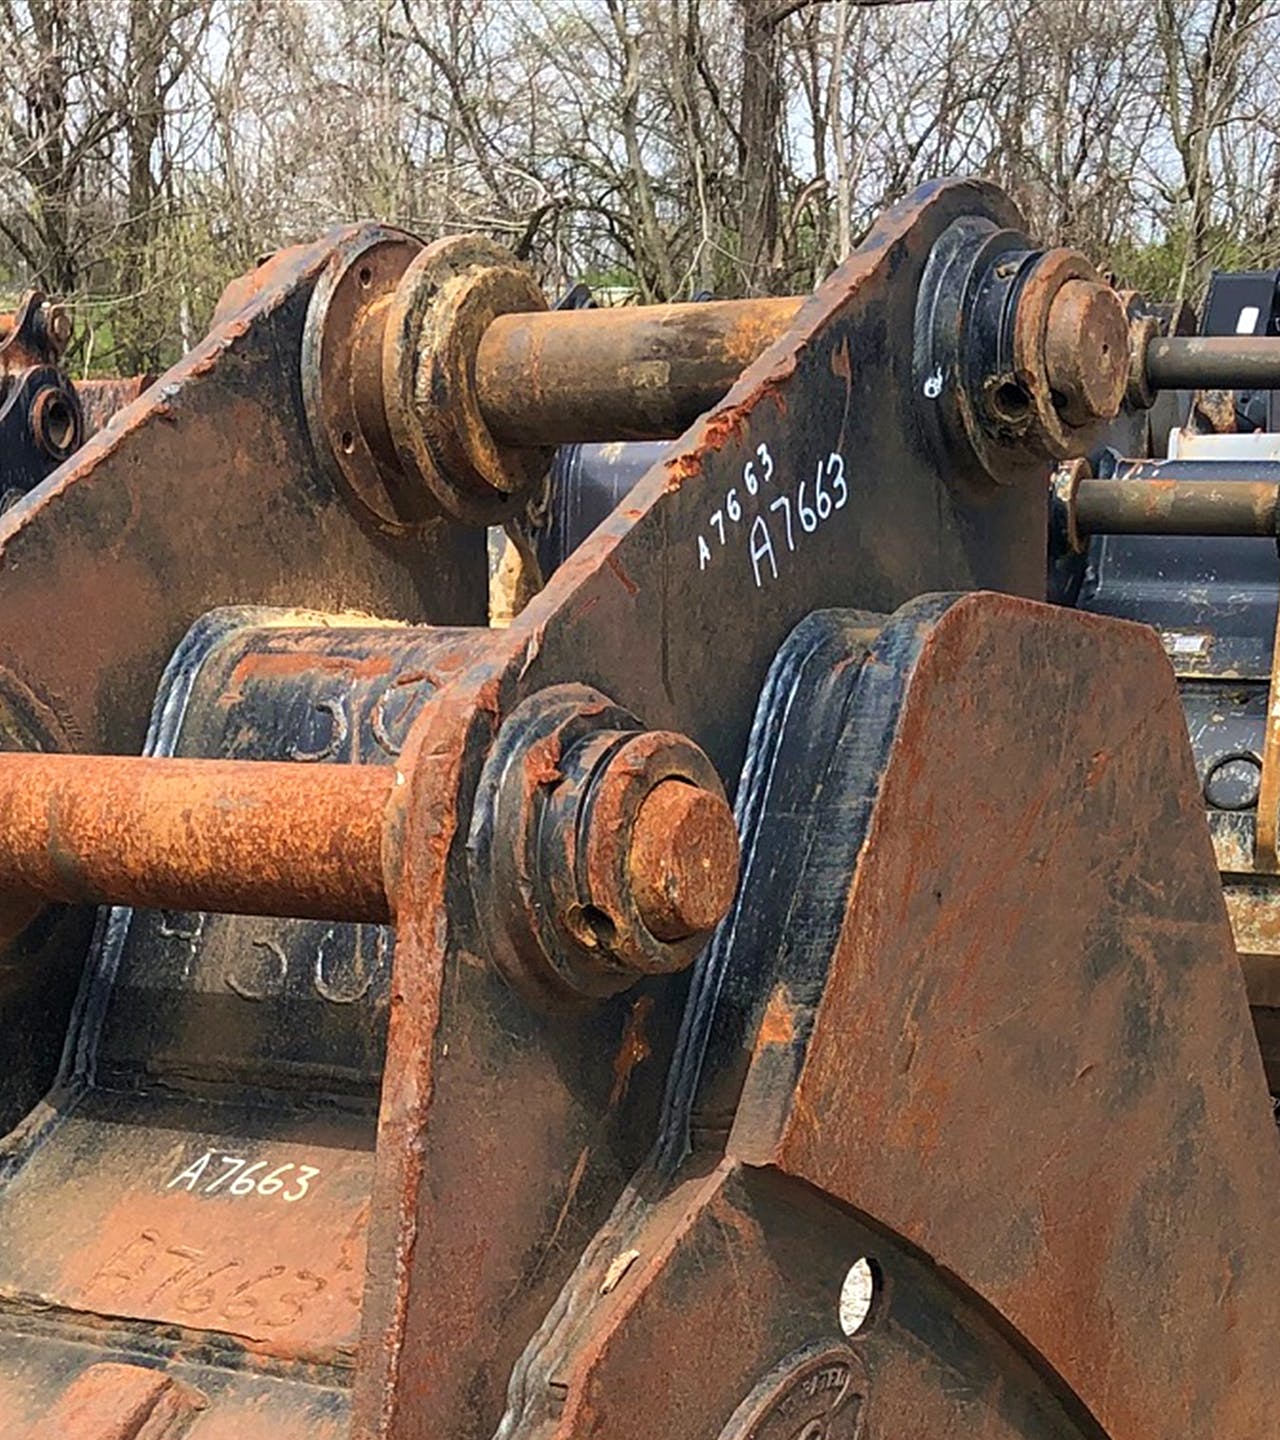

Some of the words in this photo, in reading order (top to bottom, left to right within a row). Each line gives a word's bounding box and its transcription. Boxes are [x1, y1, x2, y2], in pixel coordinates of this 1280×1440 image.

[698, 442, 775, 571] A7663
[749, 452, 848, 588] A7663
[167, 1151, 320, 1202] A7663
